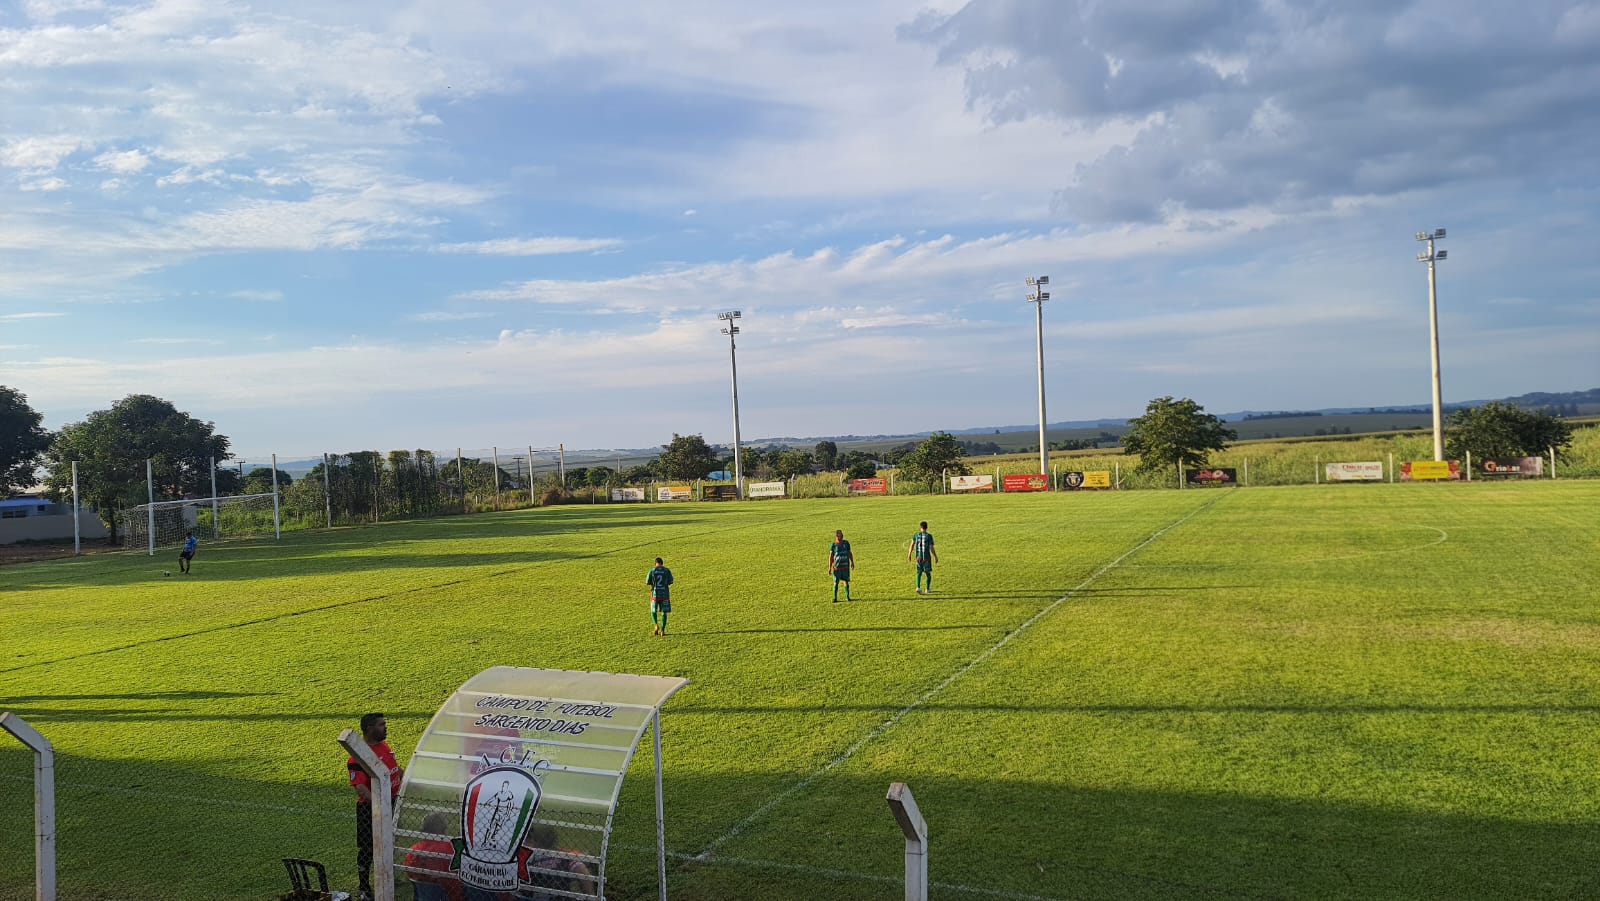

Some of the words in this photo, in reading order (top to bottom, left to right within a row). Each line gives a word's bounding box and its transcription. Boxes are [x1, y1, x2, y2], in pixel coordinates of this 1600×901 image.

[656, 574, 663, 587] 2
[476, 696, 525, 710] CAMPO
[526, 700, 550, 713] DE
[553, 702, 618, 719] FUTEBOL
[475, 713, 551, 732] SARGENTO
[549, 719, 590, 735] DIAS
